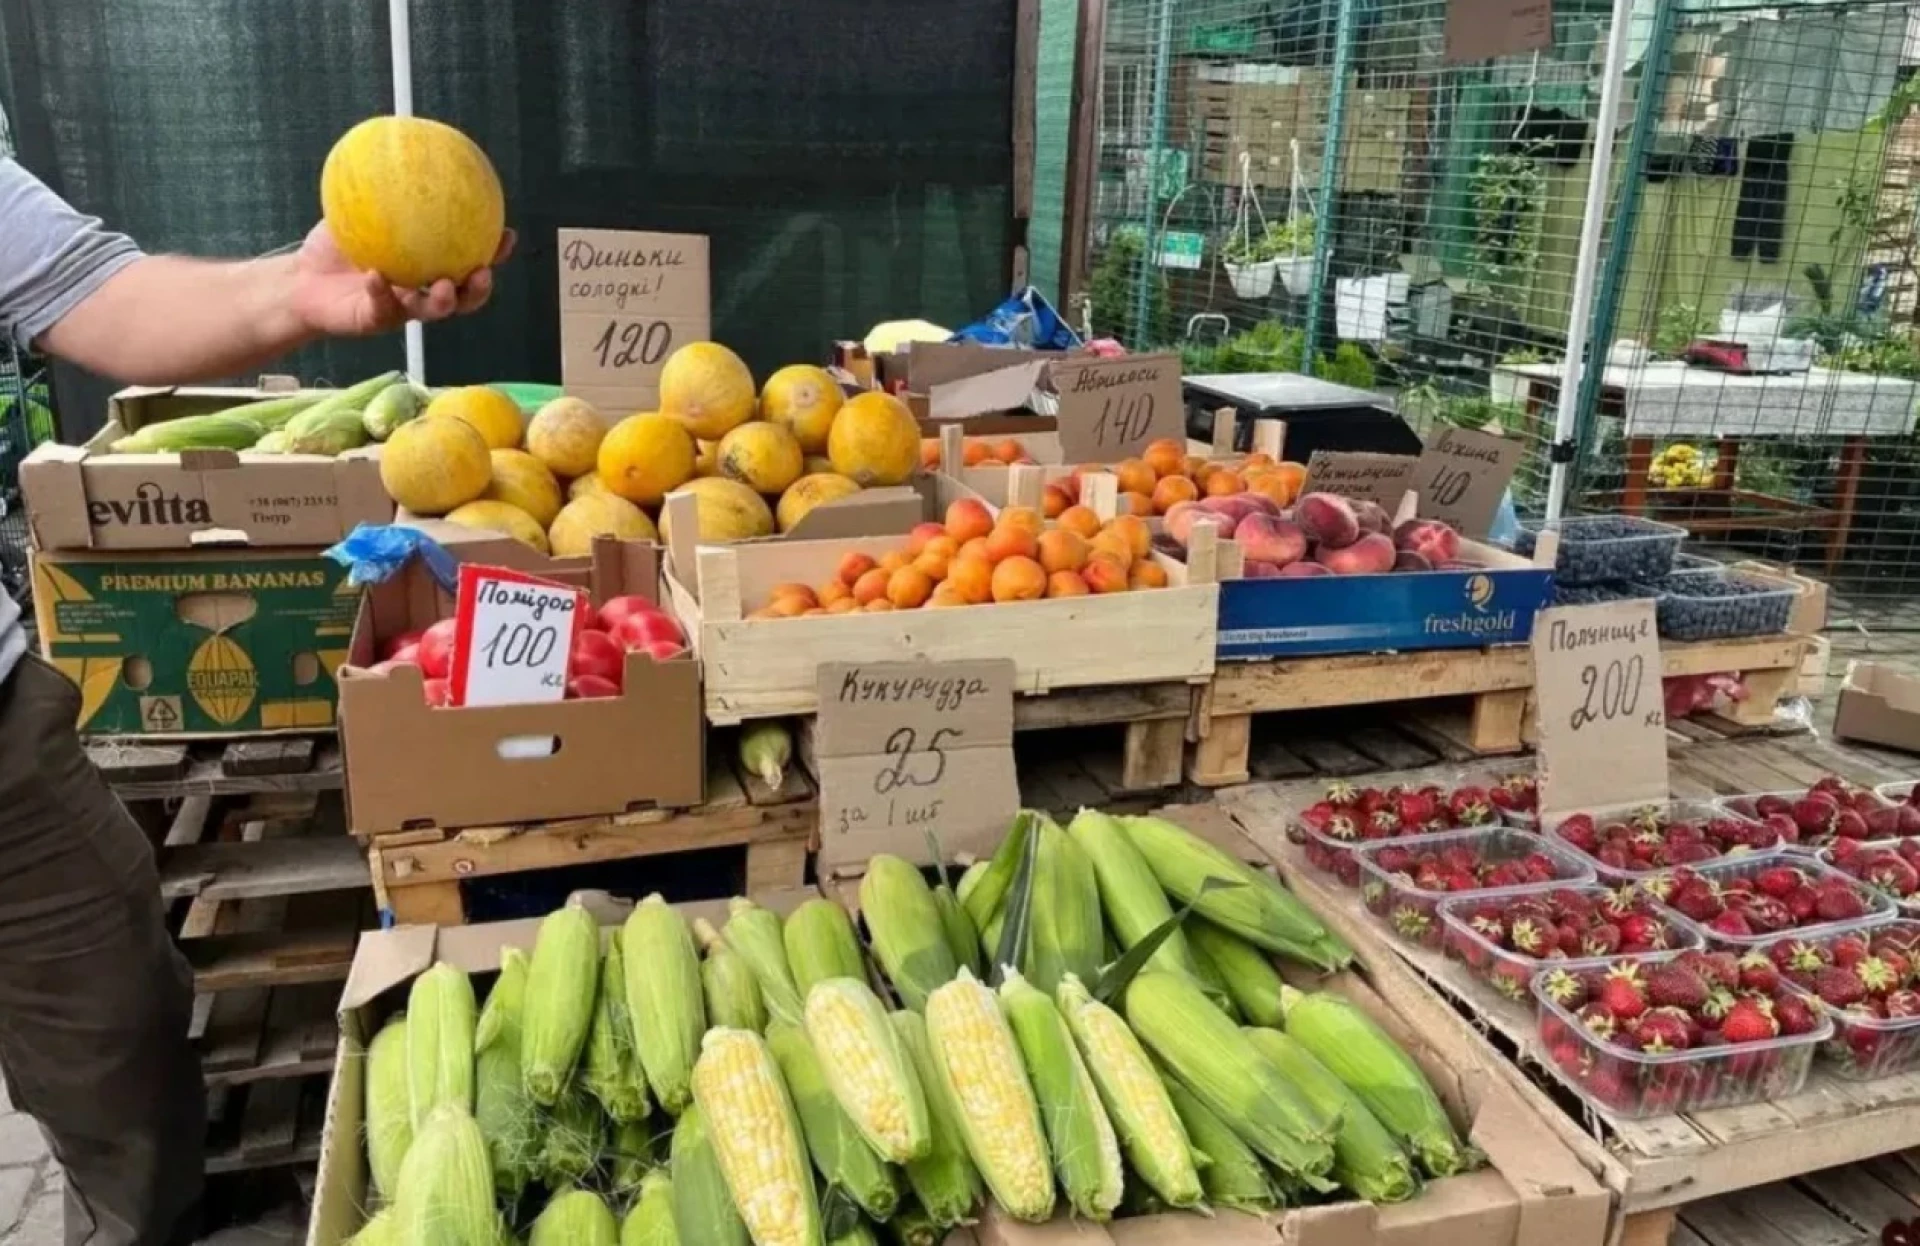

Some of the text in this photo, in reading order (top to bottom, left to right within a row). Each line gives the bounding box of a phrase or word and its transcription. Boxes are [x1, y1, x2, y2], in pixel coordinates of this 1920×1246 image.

[564, 239, 684, 271] Диньки
[570, 273, 664, 310] солодкі!
[594, 319, 672, 368] 120
[1071, 367, 1160, 393] Абрикоси
[1092, 393, 1154, 447] 140
[1429, 466, 1472, 506] 40
[101, 571, 324, 591] PREMIUM BANANAS
[478, 581, 576, 621] Помідор
[1424, 609, 1516, 638] freshgold
[480, 623, 557, 667] 100
[839, 668, 990, 711] Кукурудза
[1570, 654, 1643, 731] 200
[874, 727, 964, 794] 25
[840, 806, 868, 833] за
[887, 799, 895, 827] 1
